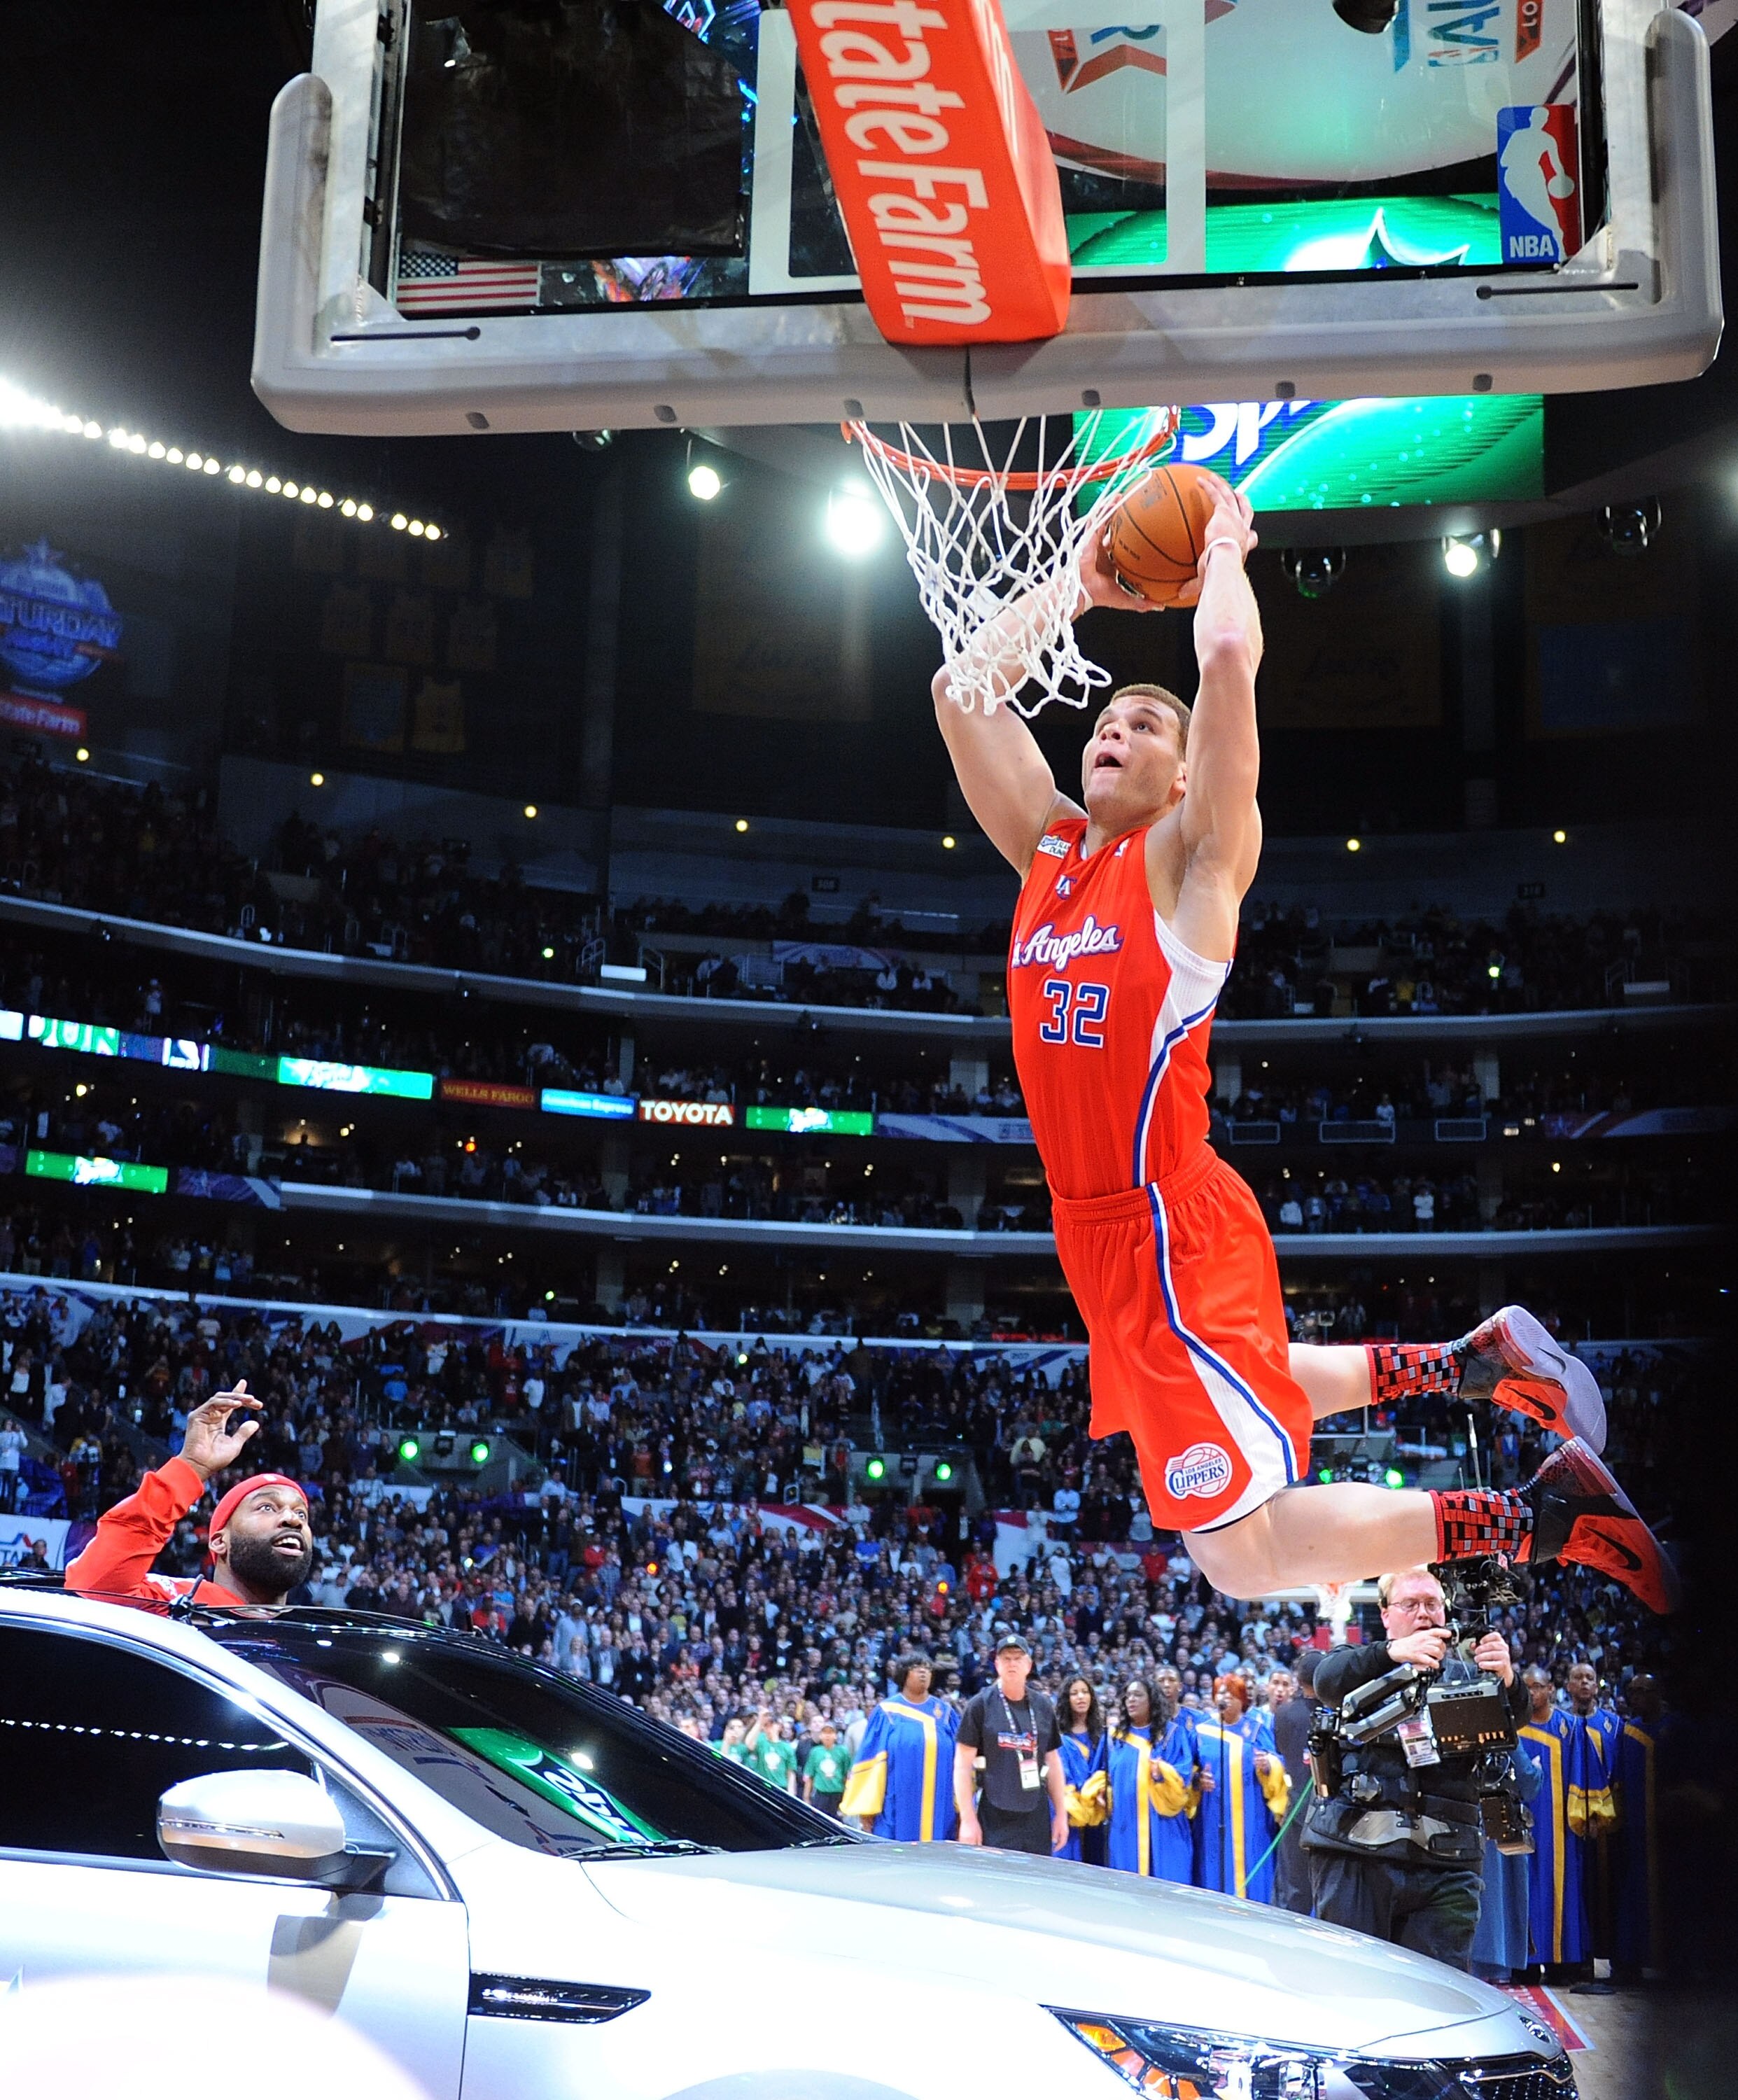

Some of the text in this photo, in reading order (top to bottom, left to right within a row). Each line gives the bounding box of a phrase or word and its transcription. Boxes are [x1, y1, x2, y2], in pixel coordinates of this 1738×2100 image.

[1510, 234, 1555, 258] NBA
[1022, 915, 1123, 973] Angeles
[1039, 979, 1110, 1049] 32
[442, 1085, 534, 1104] WELLS FARGO
[640, 1100, 734, 1125] TOYOTA
[1197, 1458, 1222, 1471] ANGELES
[1169, 1464, 1225, 1497] CLIPPERS
